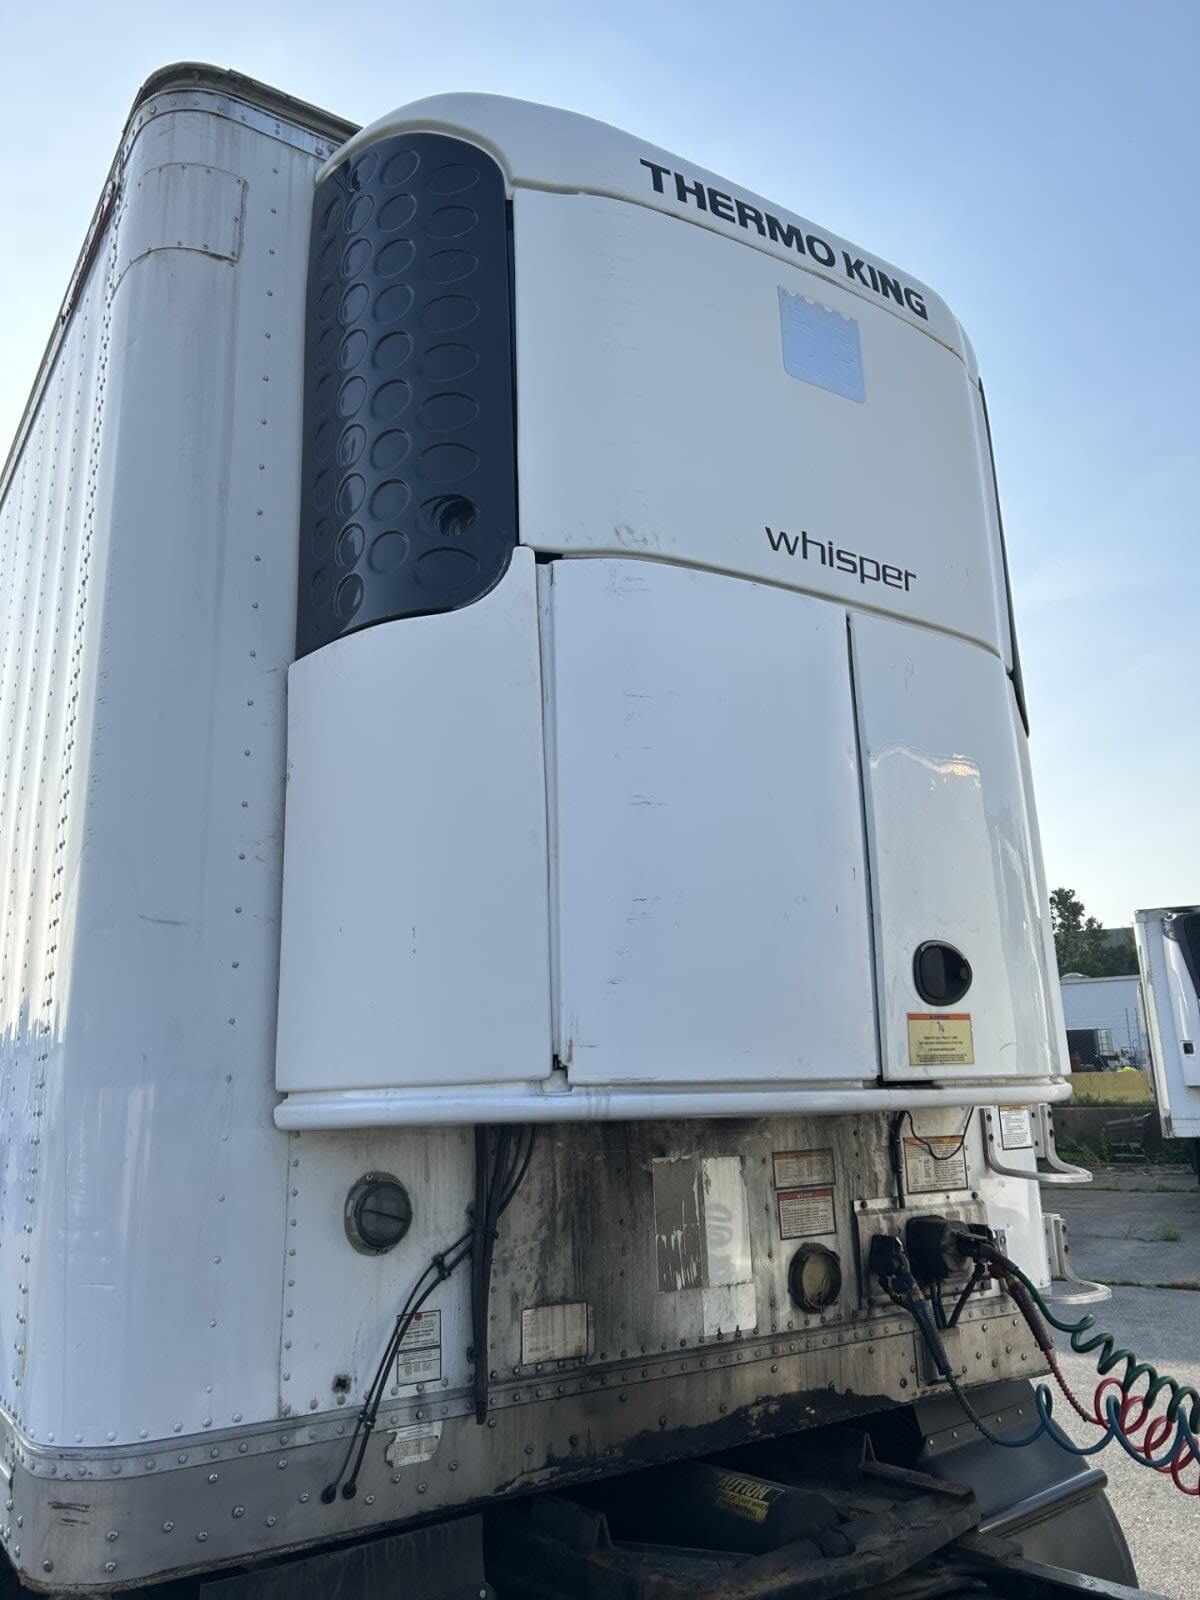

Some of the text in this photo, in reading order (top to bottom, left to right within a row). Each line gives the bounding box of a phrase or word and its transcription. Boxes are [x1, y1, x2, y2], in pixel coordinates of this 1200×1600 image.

[640, 158, 929, 321] THERMO KING
[765, 526, 917, 592] whisper
